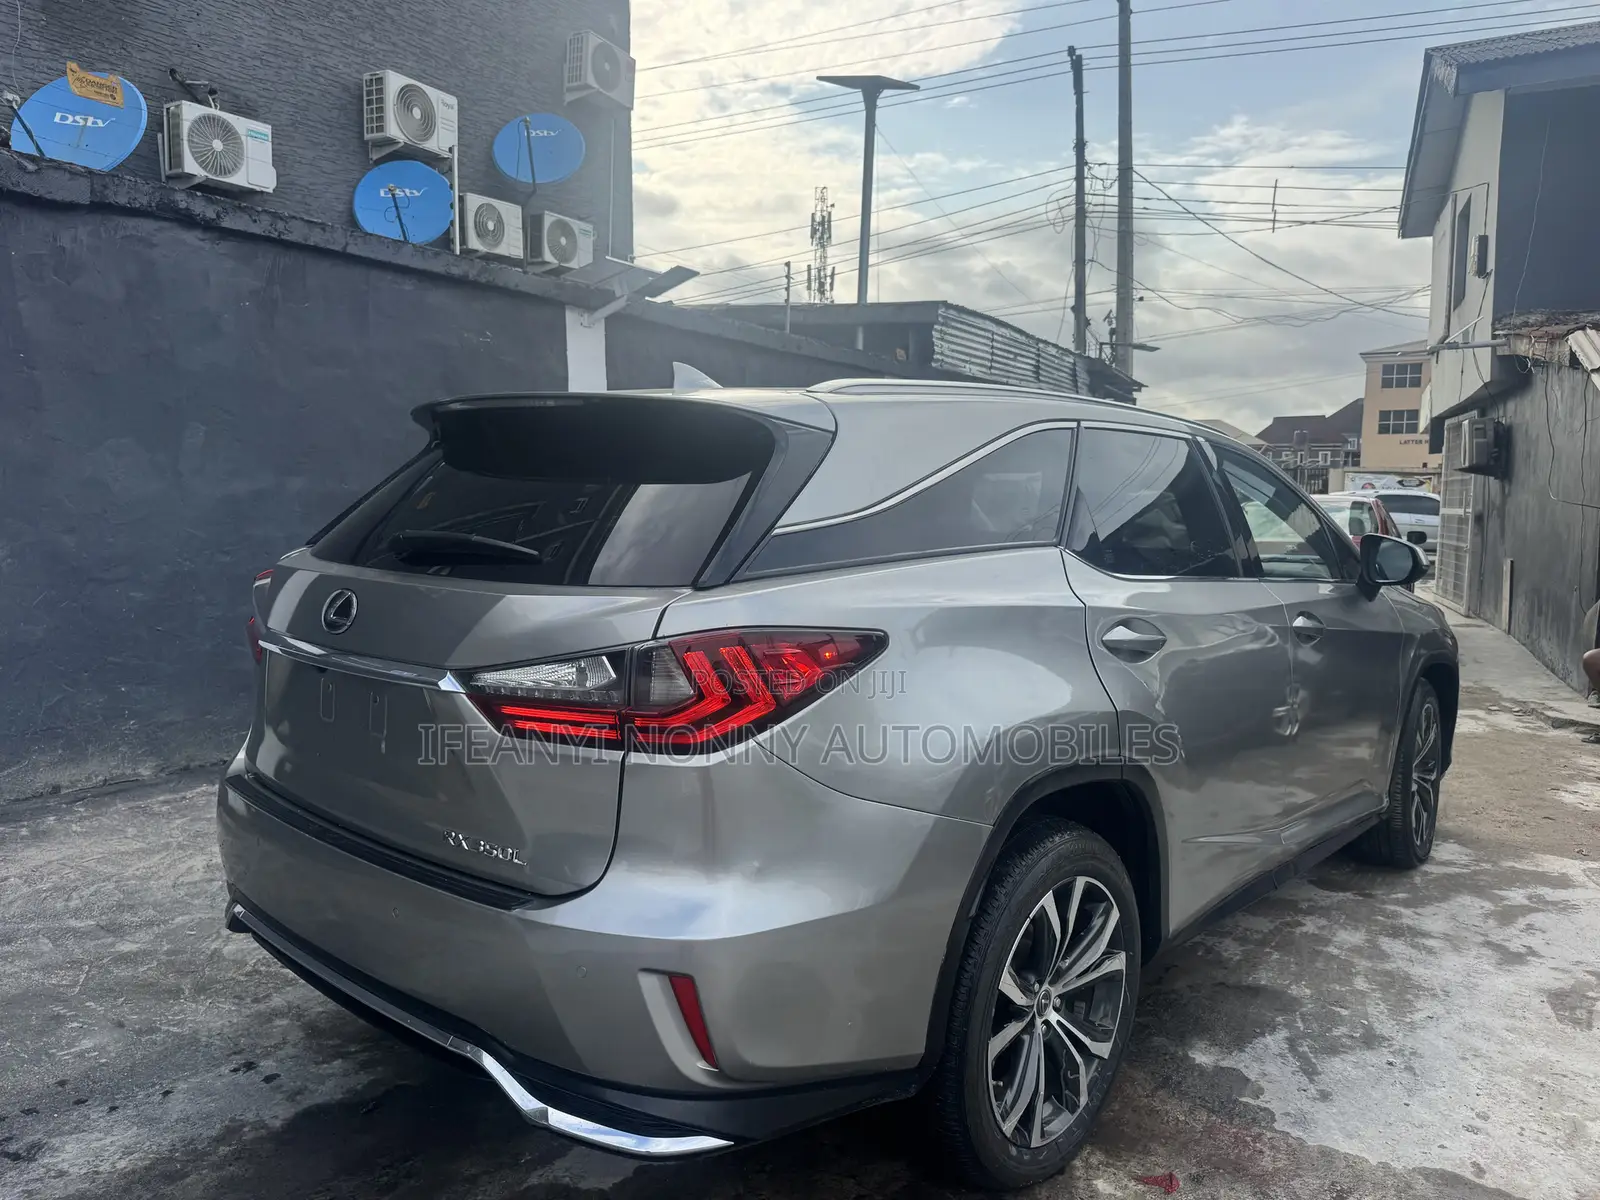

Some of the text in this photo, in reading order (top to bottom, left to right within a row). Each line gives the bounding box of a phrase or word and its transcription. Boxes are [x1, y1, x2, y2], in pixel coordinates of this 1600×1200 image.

[53, 112, 116, 127] DStv
[443, 829, 528, 866] RX 350L
